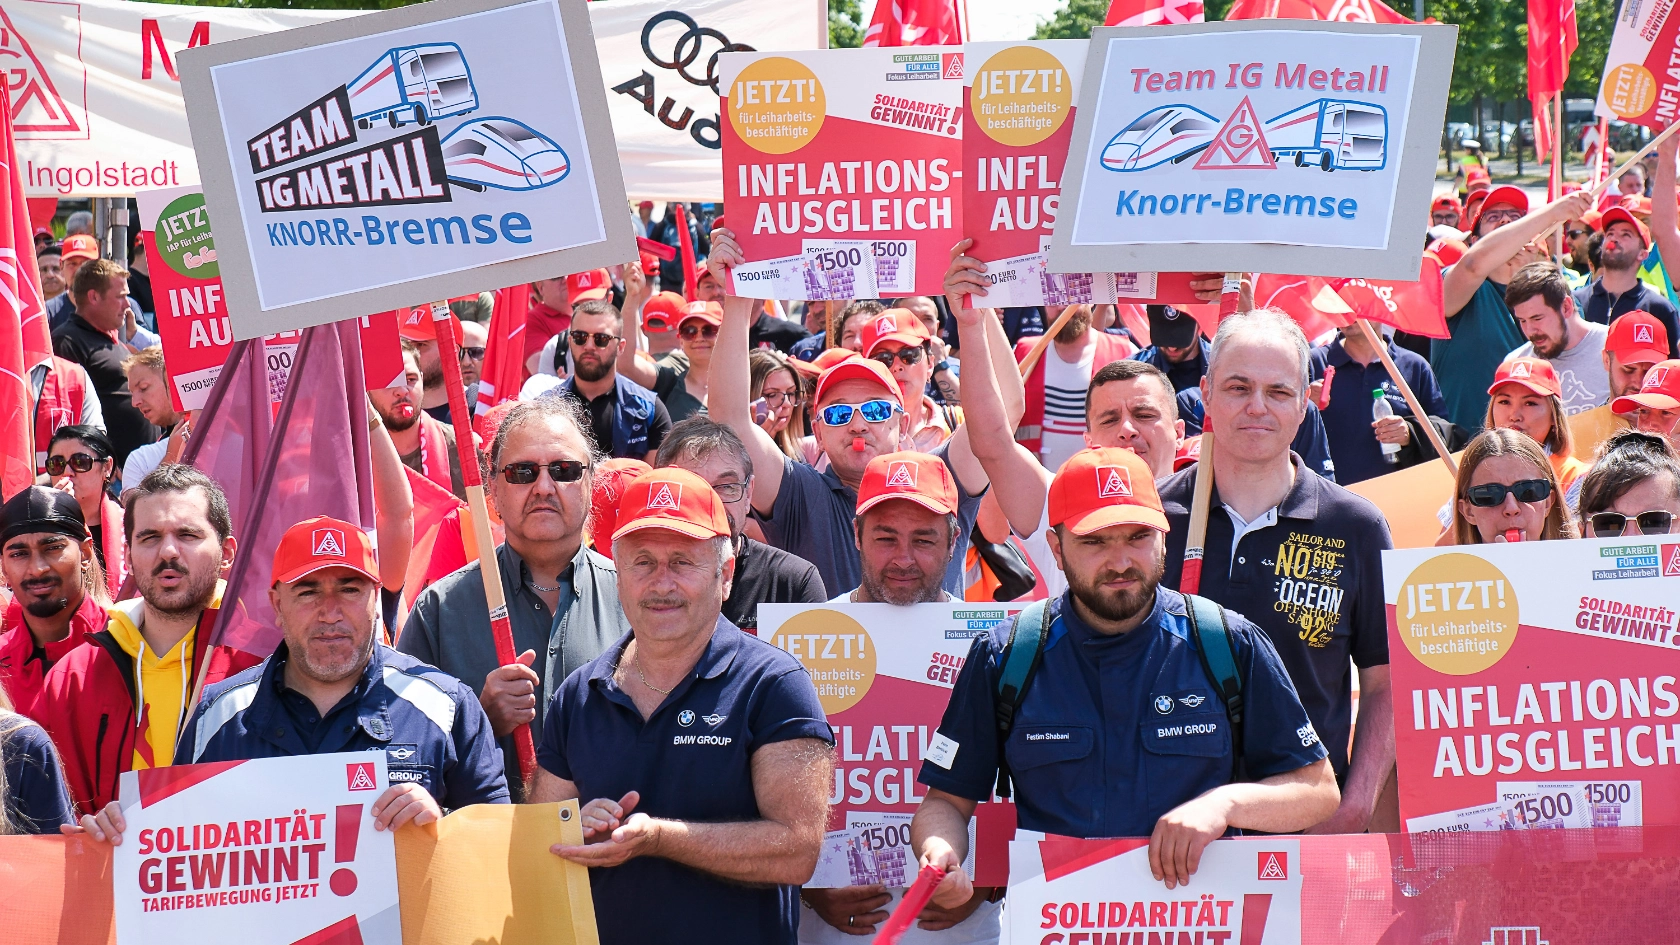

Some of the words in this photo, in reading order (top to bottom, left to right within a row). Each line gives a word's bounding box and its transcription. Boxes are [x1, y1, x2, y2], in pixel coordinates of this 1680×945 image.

[888, 73, 906, 81] Fokus
[908, 63, 921, 71] FÜR
[1130, 67, 1215, 93] Team
[1225, 62, 1265, 88] IG
[1275, 62, 1389, 92] Metall
[736, 78, 816, 109] JETZT!
[979, 69, 1063, 100] JETZT!
[1612, 66, 1634, 114] JETZT!
[611, 69, 721, 150] Aud
[874, 93, 951, 118] SOLIDARITÄT
[982, 103, 996, 115] für
[998, 102, 1061, 114] Leiharbeits-
[739, 112, 754, 124] für
[756, 111, 816, 123] Leiharbeits-
[988, 117, 1052, 131] beschäftigte
[251, 96, 351, 168] TEAM
[746, 126, 808, 139] beschäftigte
[28, 160, 179, 194] Ingolstadt
[261, 176, 294, 210] IG
[297, 136, 443, 206] METALL
[738, 158, 962, 197] INFLATIONS-
[1116, 187, 1358, 219] Knorr-Bremse
[753, 197, 952, 235] AUSGLEICH
[267, 211, 533, 246] KNORR-Bremse
[166, 242, 180, 253] IAP
[180, 238, 192, 248] für
[192, 231, 213, 244] Leiha
[870, 241, 907, 257] 1500
[815, 247, 862, 271] 1500
[737, 271, 760, 281] 1500
[998, 269, 1016, 278] EURO
[999, 275, 1017, 283] NETTO
[181, 380, 203, 393] 1500
[1289, 531, 1323, 545] SAILOR
[1324, 538, 1345, 548] AND
[1602, 548, 1624, 556] GUTE
[1626, 545, 1655, 555] ARBEIT
[1274, 543, 1311, 579] NO
[1619, 557, 1635, 567] FÜR
[1637, 557, 1656, 566] ALLE
[1594, 570, 1617, 579] Fokus
[1619, 569, 1657, 578] Leiharbeit
[1279, 579, 1344, 614] OCEAN
[1406, 579, 1506, 620] JETZT!
[1274, 601, 1341, 624] OFFSHORE
[1579, 596, 1675, 625] SOLIDARITÄT
[969, 619, 983, 628] FÜR
[1299, 614, 1324, 642] 92
[1411, 624, 1428, 638] für
[1431, 620, 1507, 637] Leiharbeits-
[1420, 638, 1498, 655] beschäftigte
[810, 668, 865, 680] iharbeits-
[815, 684, 856, 698] äftigte
[1412, 675, 1680, 730] INFLATIONS
[673, 735, 696, 745] BMW
[697, 735, 732, 746] GROUP
[1026, 733, 1045, 741] Festim
[1045, 732, 1070, 740] Shabani
[1157, 726, 1183, 738] BMW
[1184, 723, 1217, 735] GROUP
[1433, 723, 1680, 777] AUSGLEICH
[389, 771, 423, 781] GROUP
[1584, 783, 1631, 804] 1500
[1514, 792, 1573, 824] 1500
[138, 808, 326, 854] SOLIDARITÄT
[861, 823, 911, 851] 1500
[142, 887, 272, 913] TARIFBEWEGUNG
[275, 883, 320, 904] JETZT
[1040, 893, 1235, 930] SOLIDARITÄT
